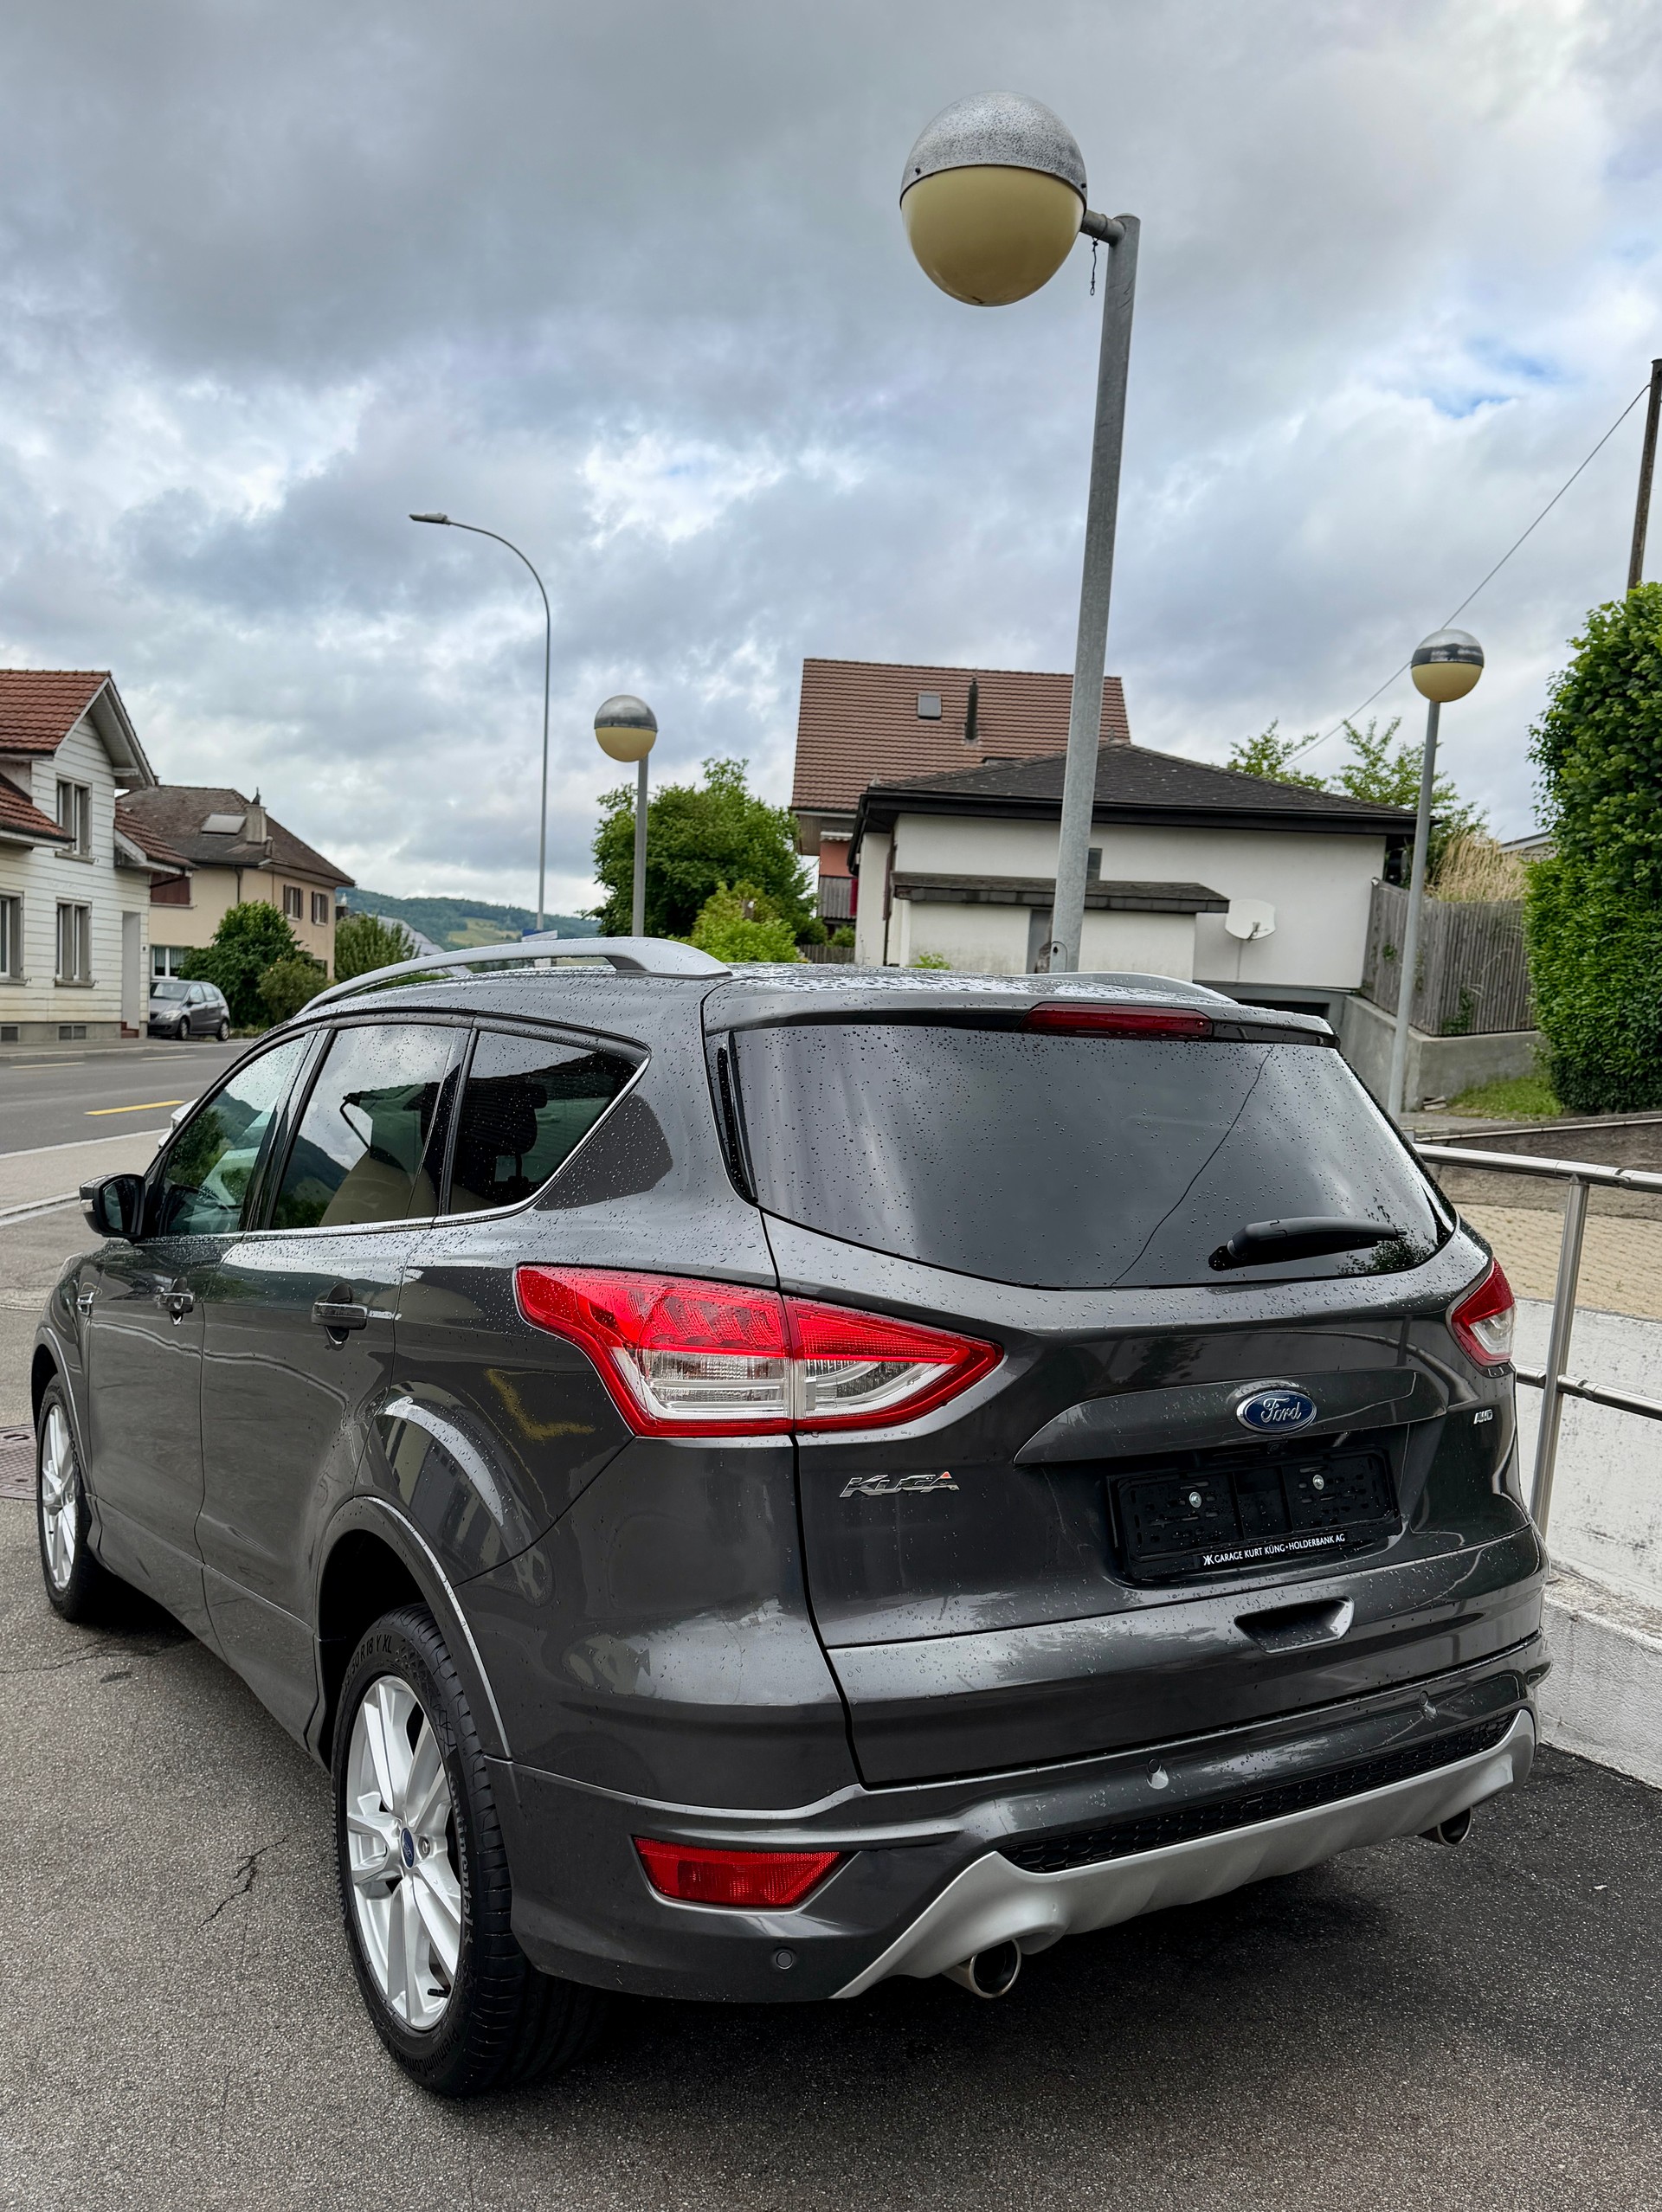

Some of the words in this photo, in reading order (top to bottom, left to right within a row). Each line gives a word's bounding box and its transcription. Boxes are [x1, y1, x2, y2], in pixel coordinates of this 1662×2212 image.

[1260, 1397, 1302, 1424] Ford
[839, 1471, 959, 1497] KUGA
[1214, 1551, 1244, 1564] GARAGE
[1244, 1547, 1263, 1559] KURT
[1335, 1534, 1346, 1542] AG
[382, 1634, 392, 1654] XL
